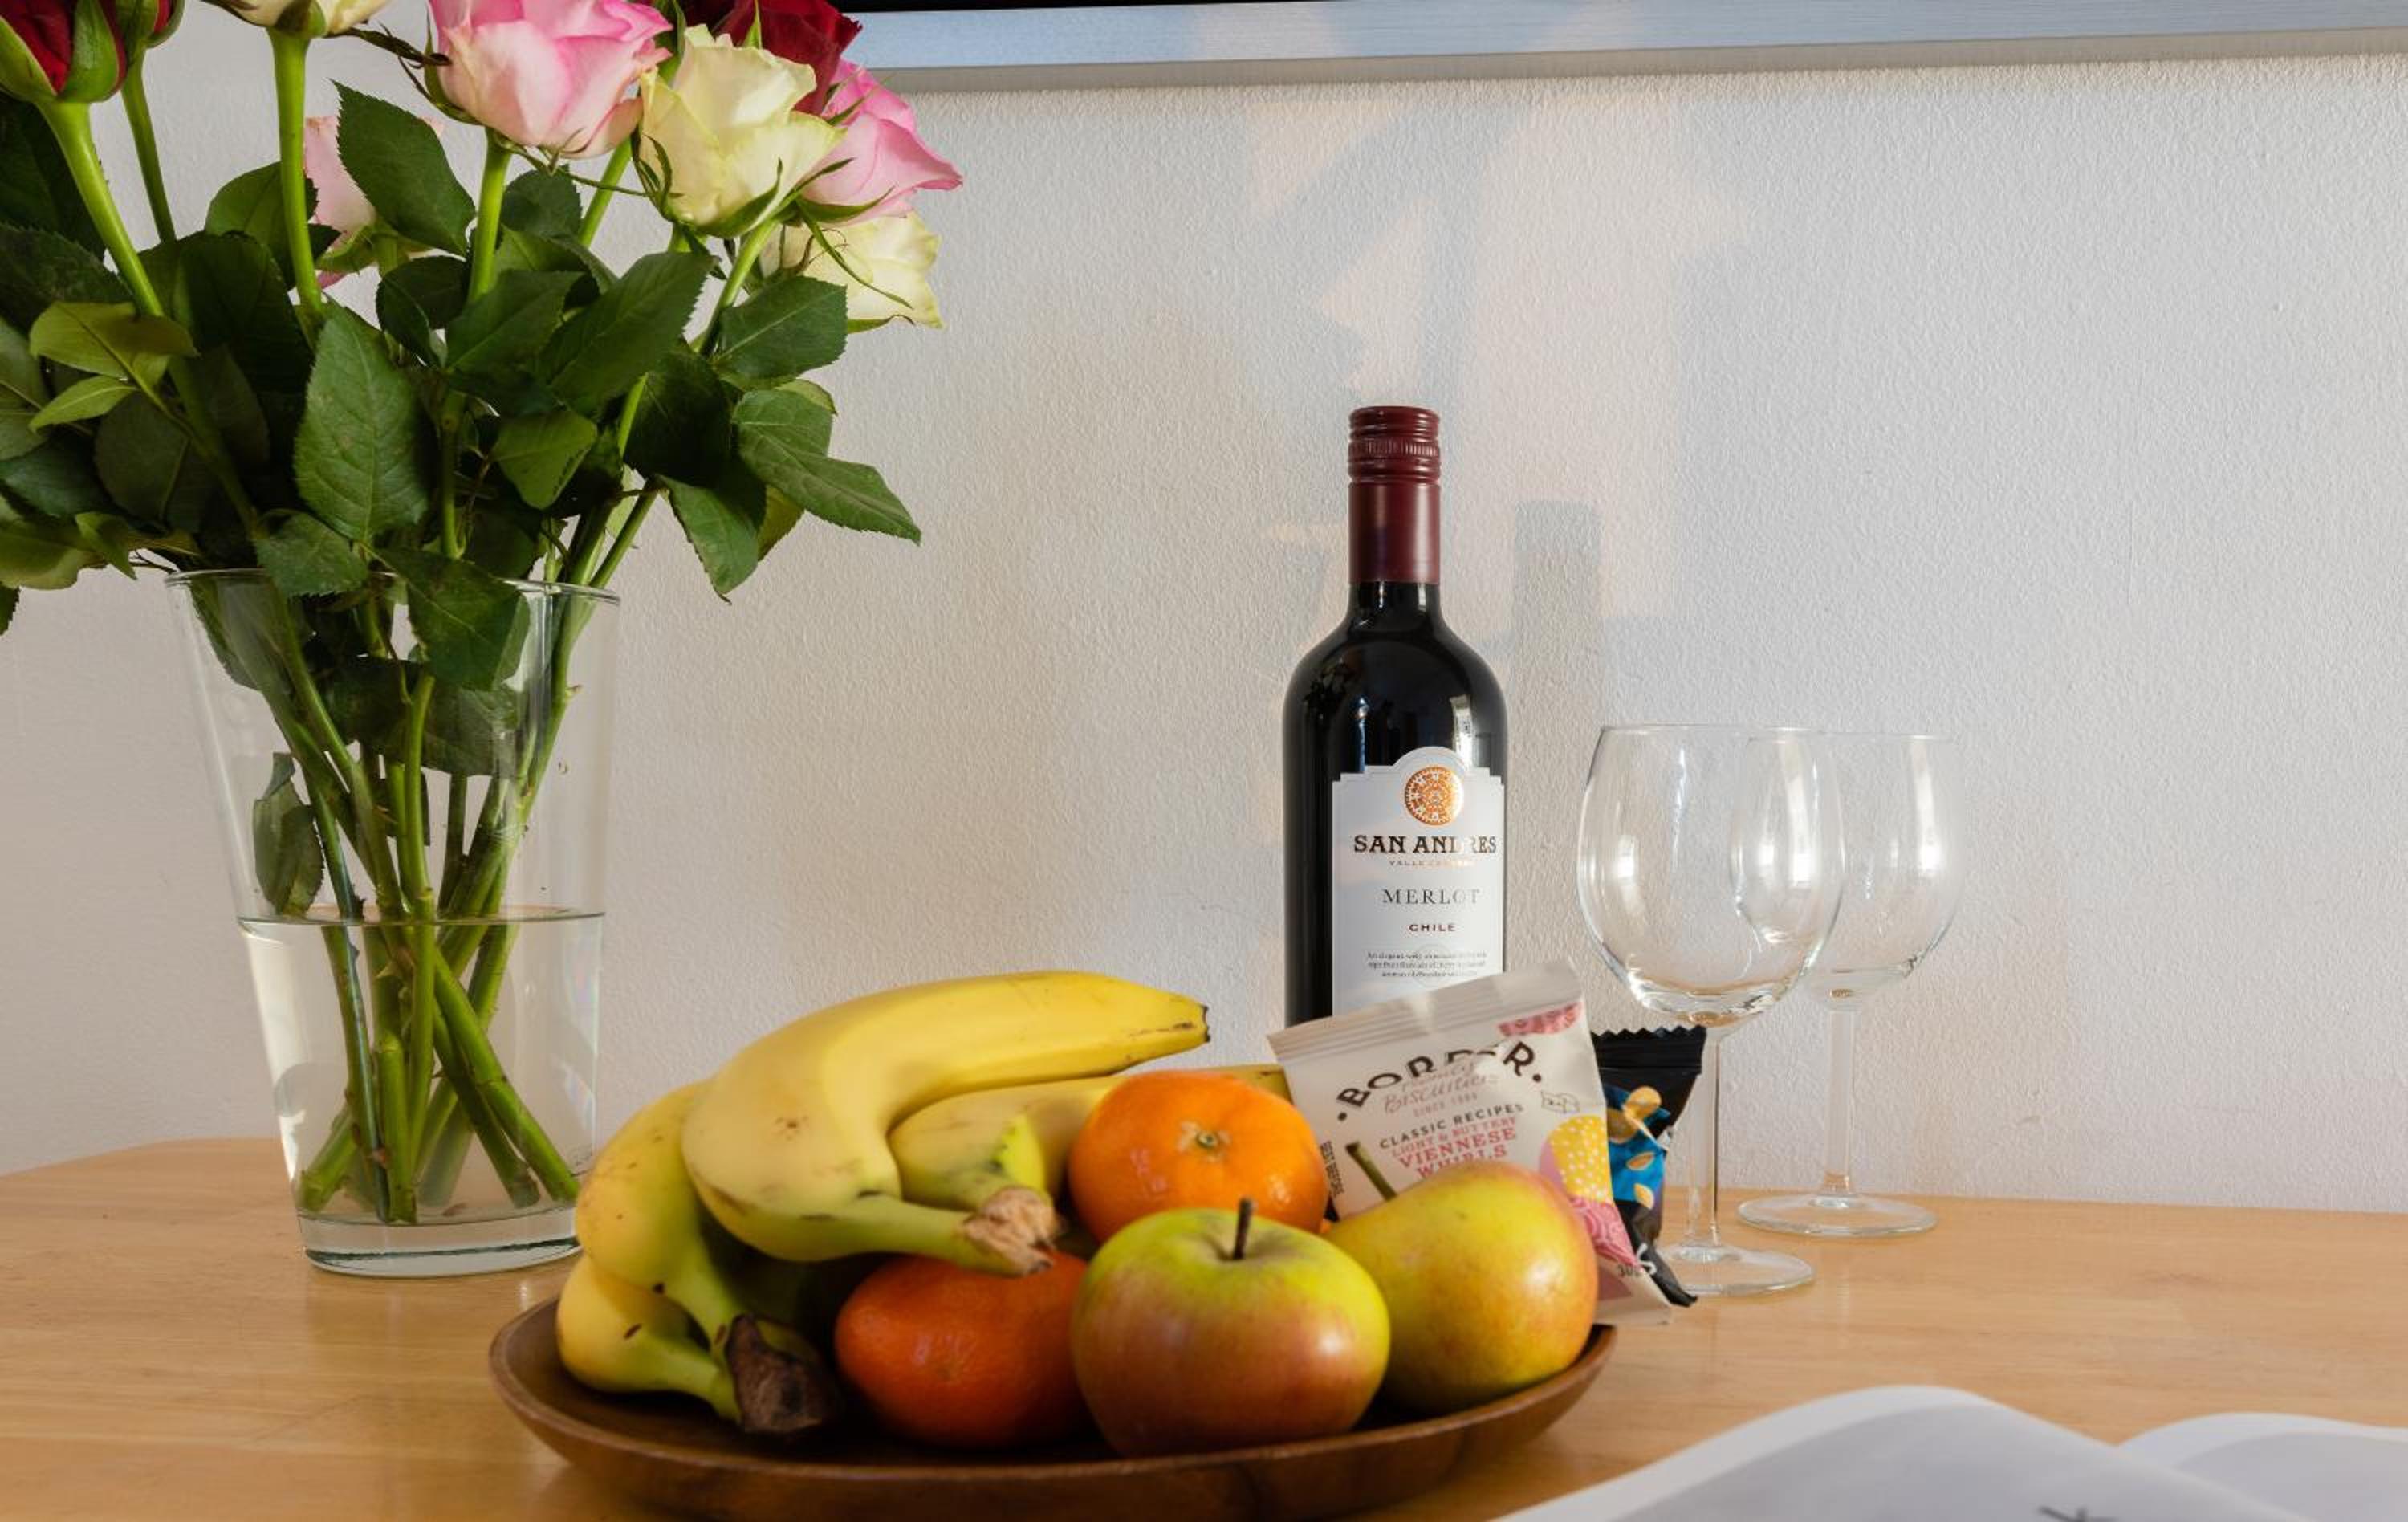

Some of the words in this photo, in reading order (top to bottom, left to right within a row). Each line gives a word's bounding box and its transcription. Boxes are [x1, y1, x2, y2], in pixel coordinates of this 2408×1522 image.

[1354, 835, 1406, 853] SAN
[1382, 889, 1480, 905] MERLOT
[1409, 924, 1457, 932] CHILE
[1336, 1041, 1536, 1109] BORR
[1380, 1120, 1447, 1149] CLASSIC
[1454, 1104, 1524, 1125] RECIPES
[1399, 1128, 1516, 1168] VIENNESE
